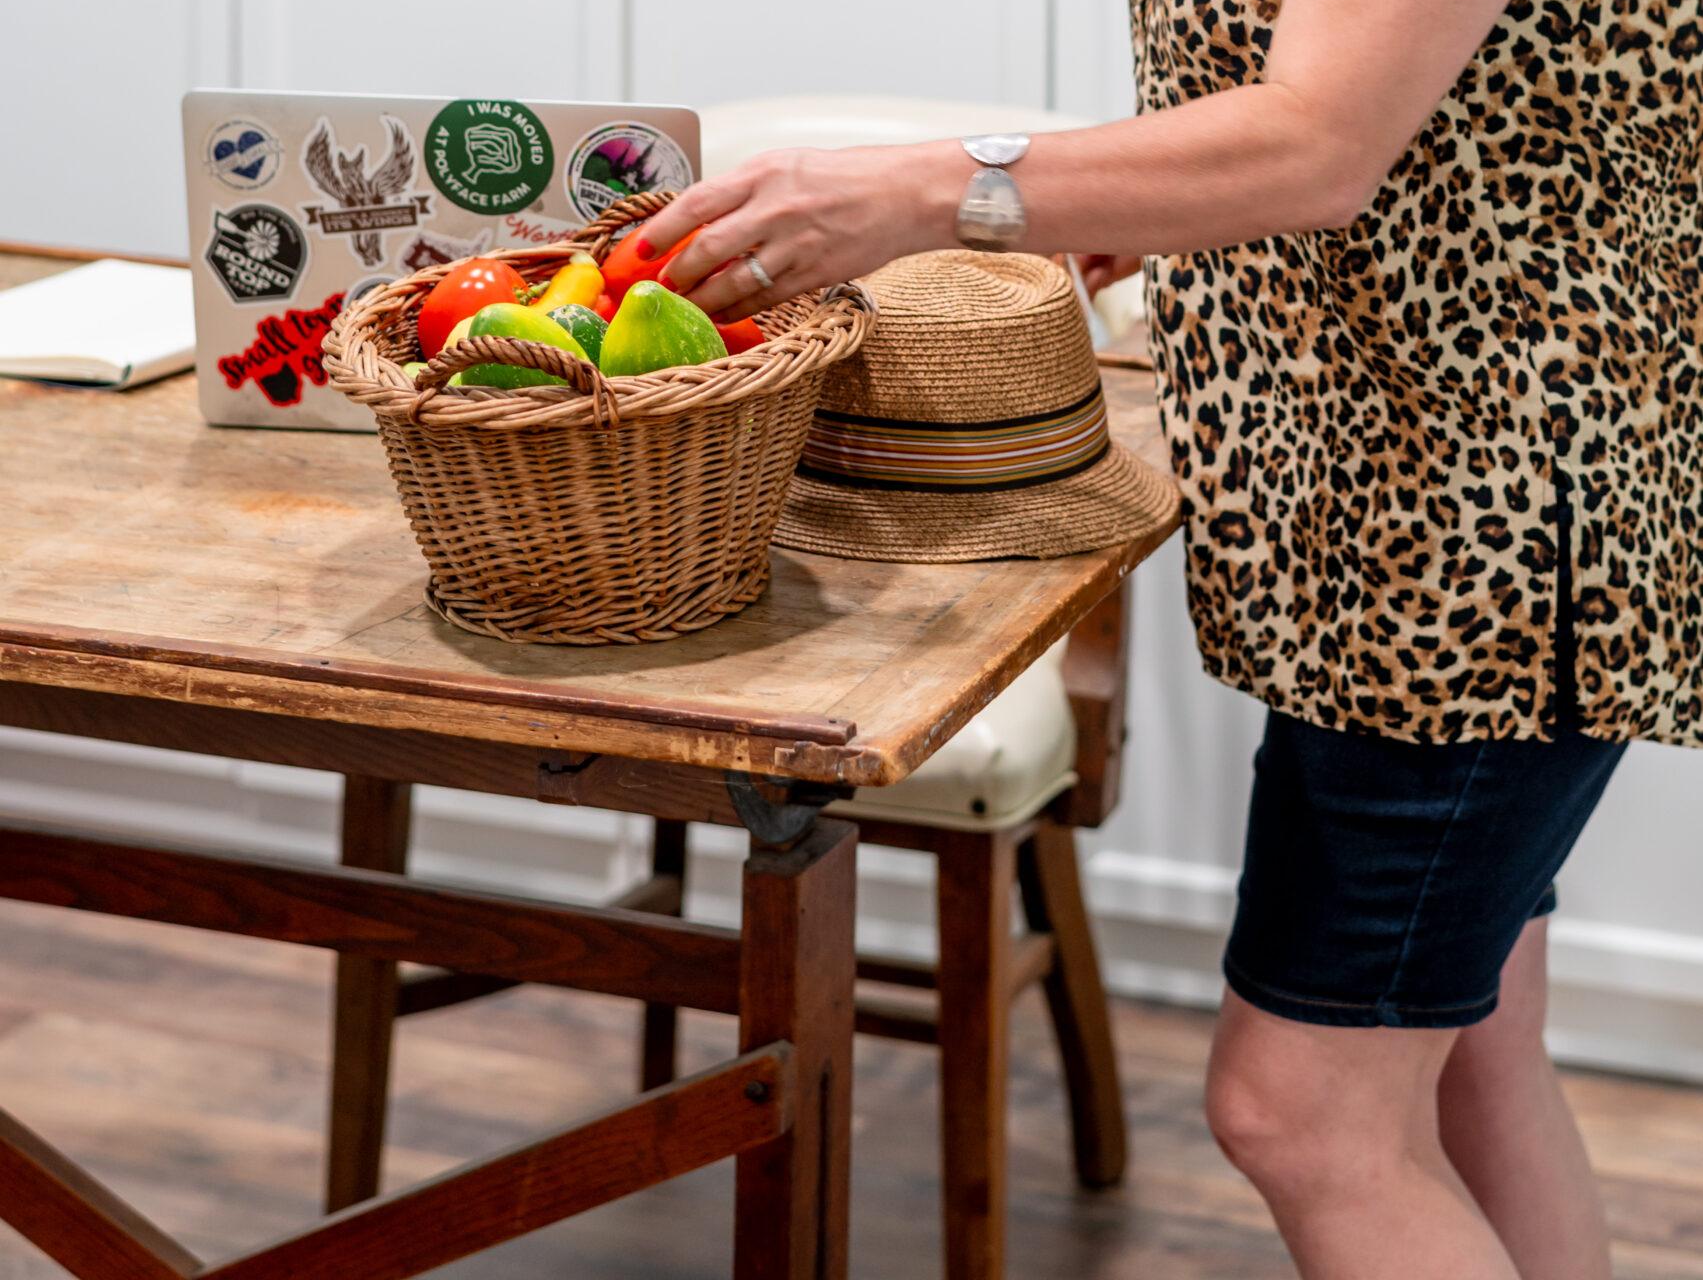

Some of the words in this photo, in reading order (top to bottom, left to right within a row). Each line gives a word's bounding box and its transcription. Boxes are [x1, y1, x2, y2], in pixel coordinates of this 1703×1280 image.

[435, 125, 450, 148] AT
[466, 104, 475, 116] I
[476, 101, 512, 118] WAS
[512, 112, 544, 165] MOVED
[433, 148, 508, 207] POLYFACE
[491, 181, 532, 207] FARM
[214, 242, 290, 289] ROUND
[225, 261, 271, 291] TOP
[222, 320, 298, 385] Small
